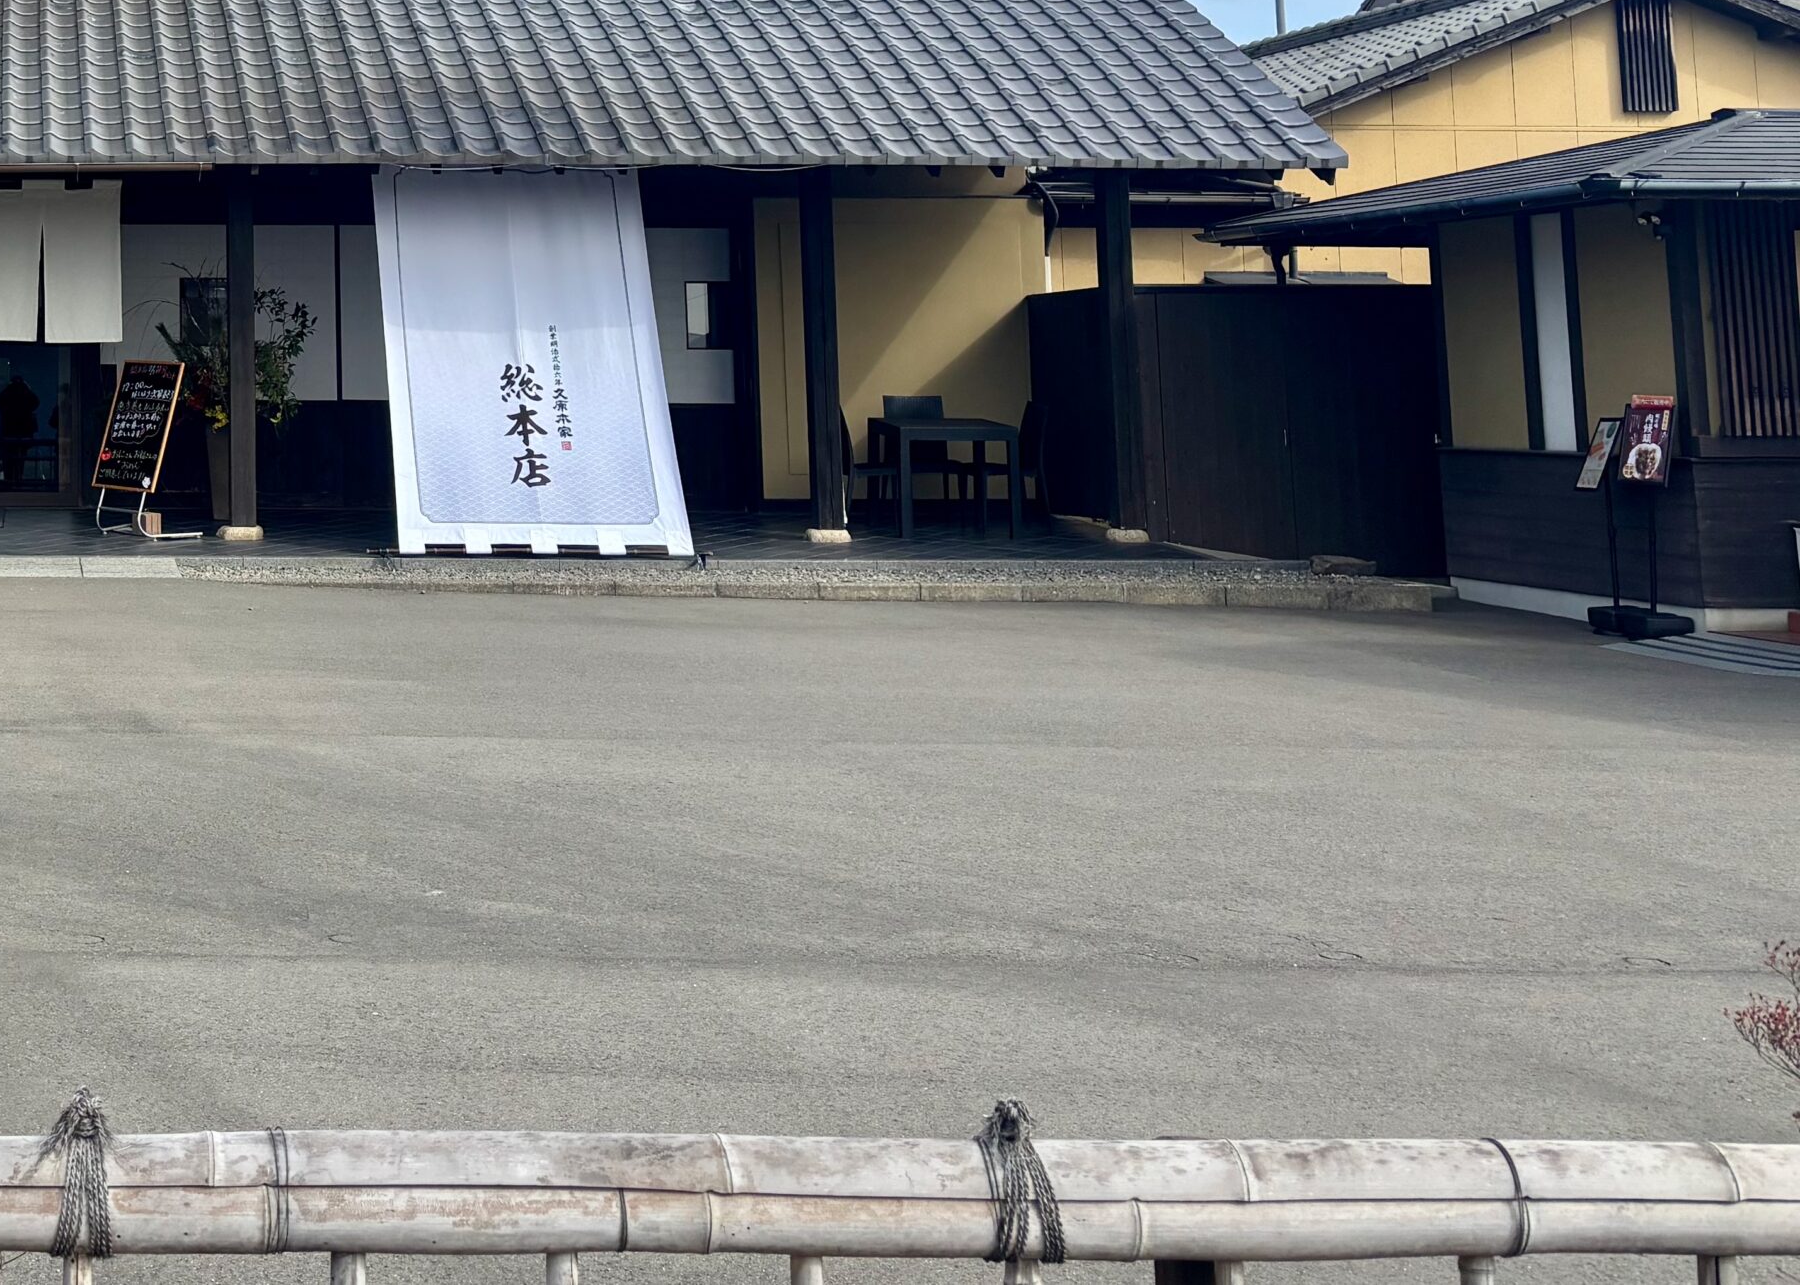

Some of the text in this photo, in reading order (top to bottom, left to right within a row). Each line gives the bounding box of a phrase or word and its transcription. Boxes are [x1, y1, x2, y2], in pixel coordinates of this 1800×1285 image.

[500, 363, 551, 488] 総本店
[552, 388, 573, 438] 久原本家
